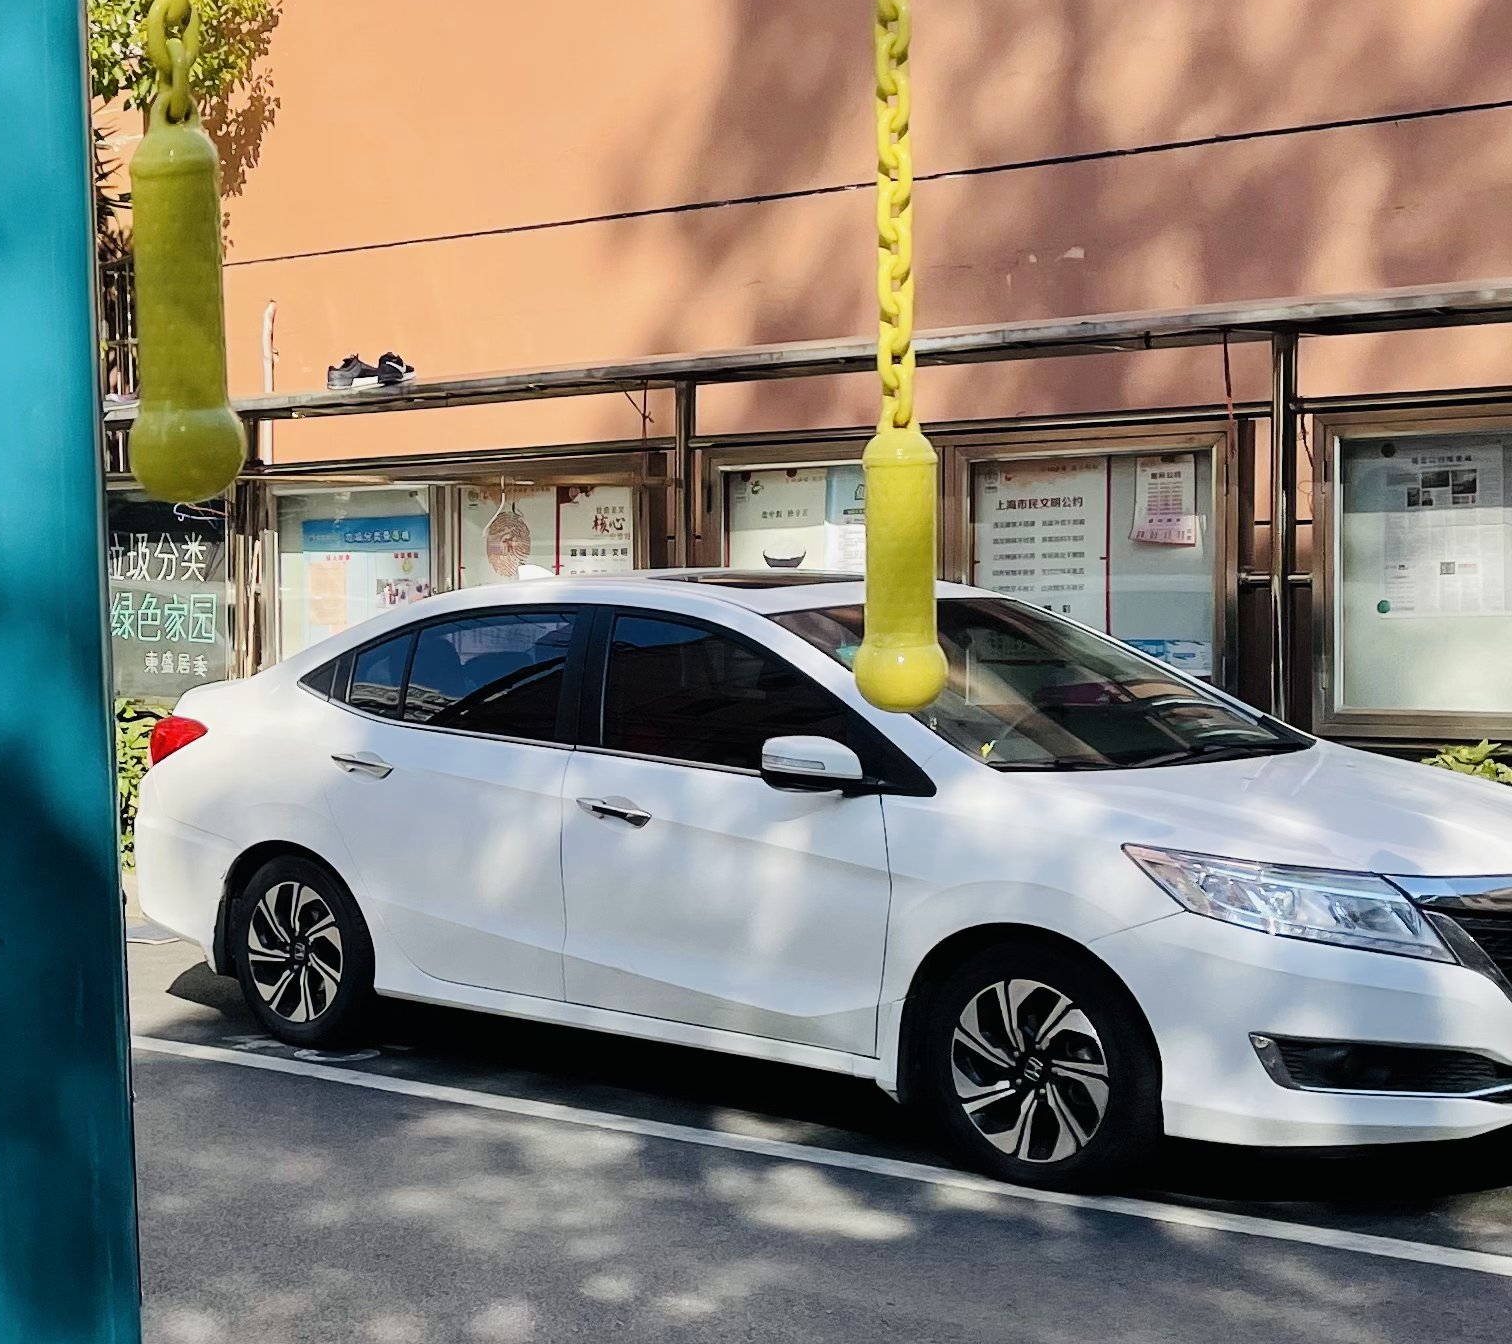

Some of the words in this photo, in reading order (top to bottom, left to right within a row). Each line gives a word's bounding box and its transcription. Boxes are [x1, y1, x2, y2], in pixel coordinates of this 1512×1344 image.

[592, 515, 625, 533] 核心
[109, 532, 207, 582] 垃圾分类
[110, 592, 217, 643] 绿色家园
